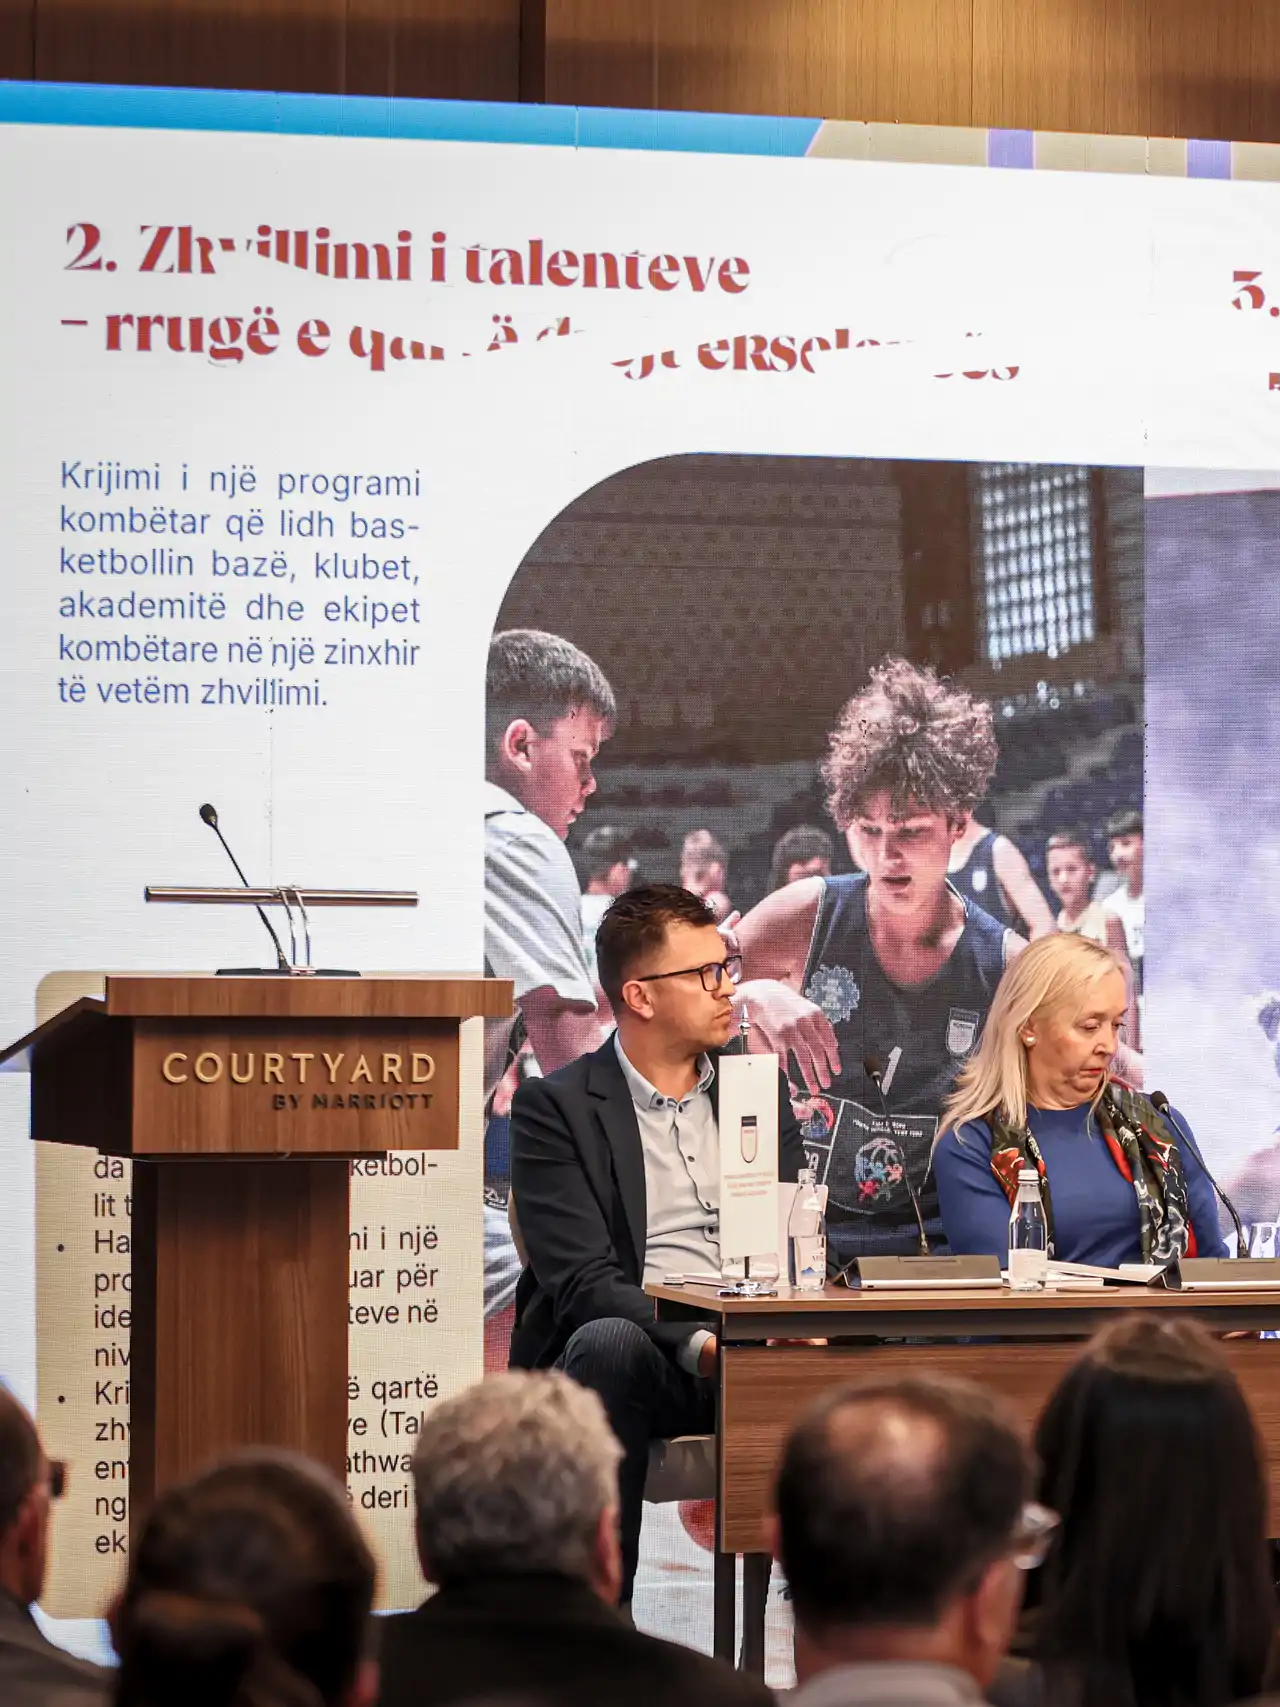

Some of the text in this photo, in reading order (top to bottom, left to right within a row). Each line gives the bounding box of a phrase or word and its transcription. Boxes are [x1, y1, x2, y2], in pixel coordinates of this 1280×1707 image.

[64, 221, 117, 272] 2.
[431, 231, 447, 282] i
[461, 238, 750, 294] talenteve
[105, 306, 280, 367] rrugë
[297, 317, 331, 357] e
[61, 461, 421, 502] Krijimi i një programi
[60, 505, 420, 541] kombëtar që lidh bas-
[60, 547, 420, 585] ketbollin bazë, klubet,
[59, 591, 420, 628] akademitë dhe ekipet
[59, 634, 420, 671] kombëtare në një zinxhir
[58, 675, 327, 706] të vetëm zhvillimi.
[162, 1053, 436, 1084] COURTYARD
[272, 1093, 433, 1110] BY MARRIOTT
[350, 1152, 438, 1176] ketbol-
[94, 1193, 116, 1217] lit
[381, 1226, 386, 1250] i
[400, 1225, 438, 1256] një
[397, 1263, 439, 1293] për
[408, 1299, 438, 1323] në
[372, 1374, 438, 1405] qartë
[361, 1484, 408, 1509] deri
